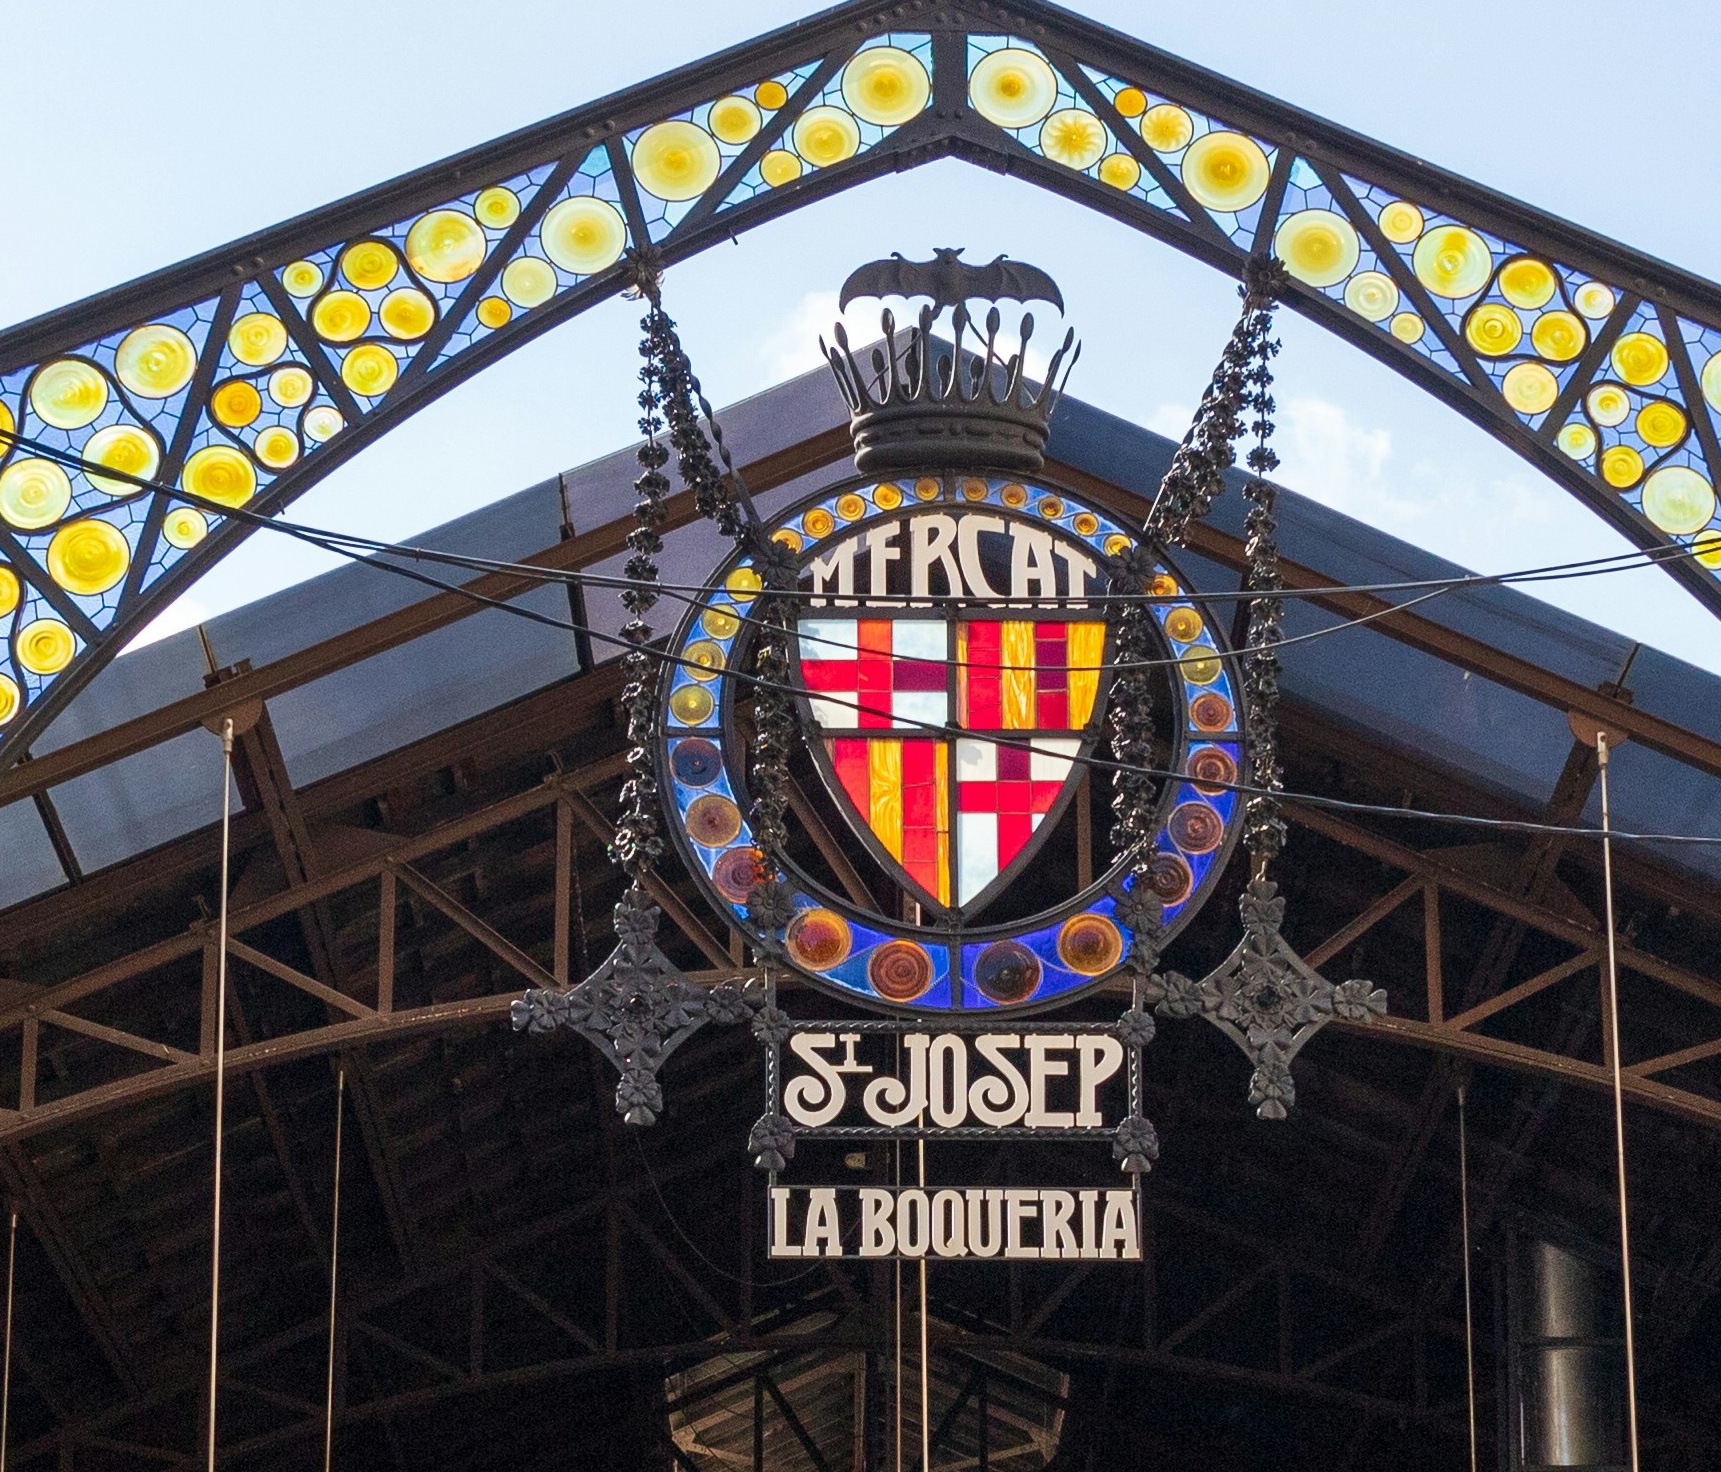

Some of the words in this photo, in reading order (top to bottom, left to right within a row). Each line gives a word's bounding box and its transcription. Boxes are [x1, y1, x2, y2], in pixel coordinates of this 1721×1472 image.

[809, 513, 1097, 609] MERCAT
[863, 1033, 1124, 1128] JOSEP
[771, 1188, 843, 1257] LA
[859, 1188, 1141, 1259] BOQUERIA
